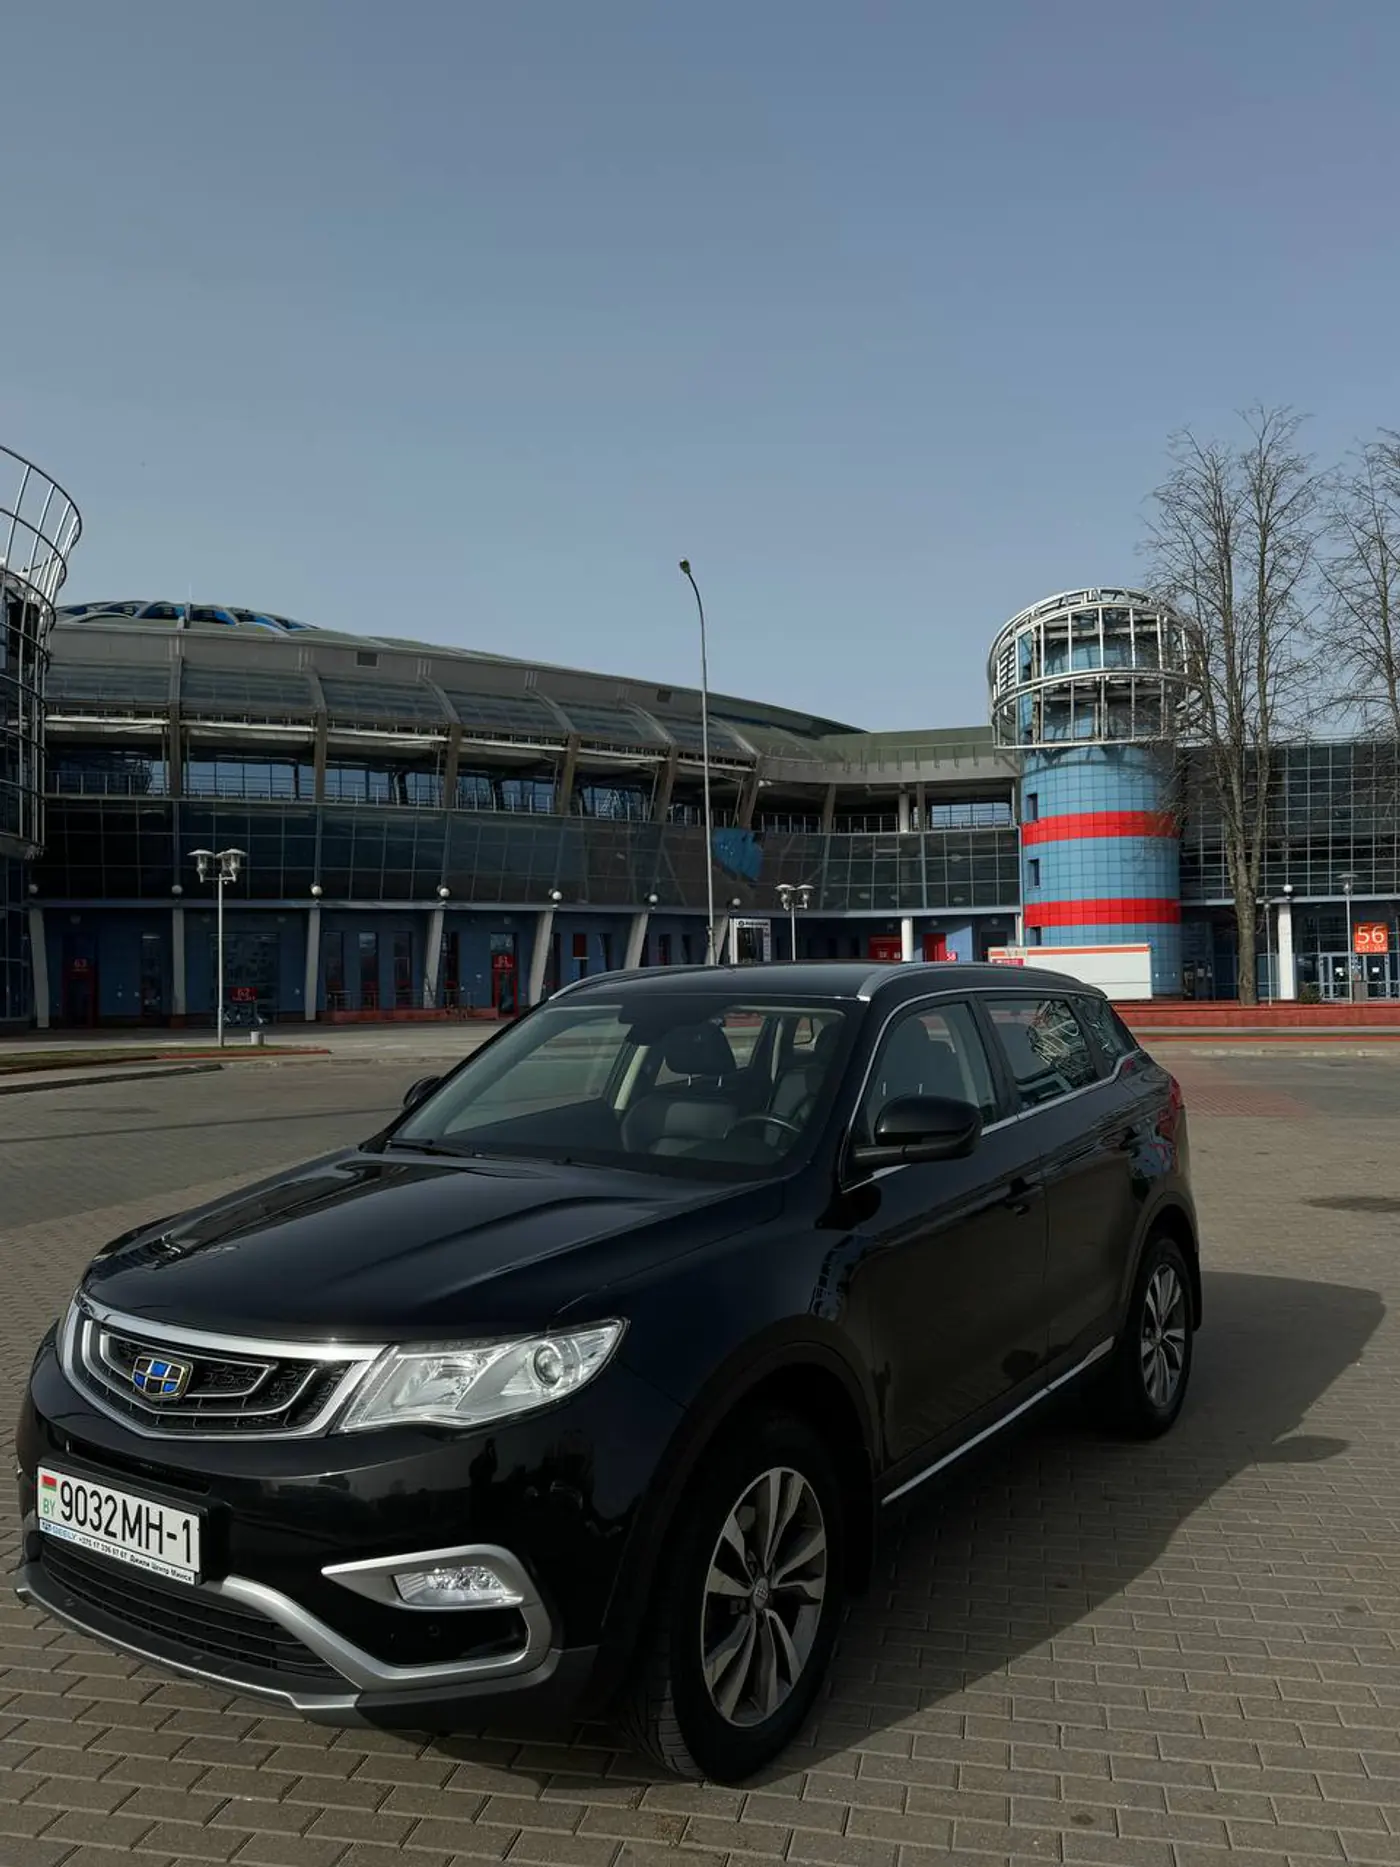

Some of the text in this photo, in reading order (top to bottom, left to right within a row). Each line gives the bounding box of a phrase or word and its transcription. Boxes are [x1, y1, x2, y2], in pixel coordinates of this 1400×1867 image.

[1357, 926, 1385, 944] 56
[43, 1498, 56, 1517] BY
[60, 1480, 191, 1564] 9032MH-1
